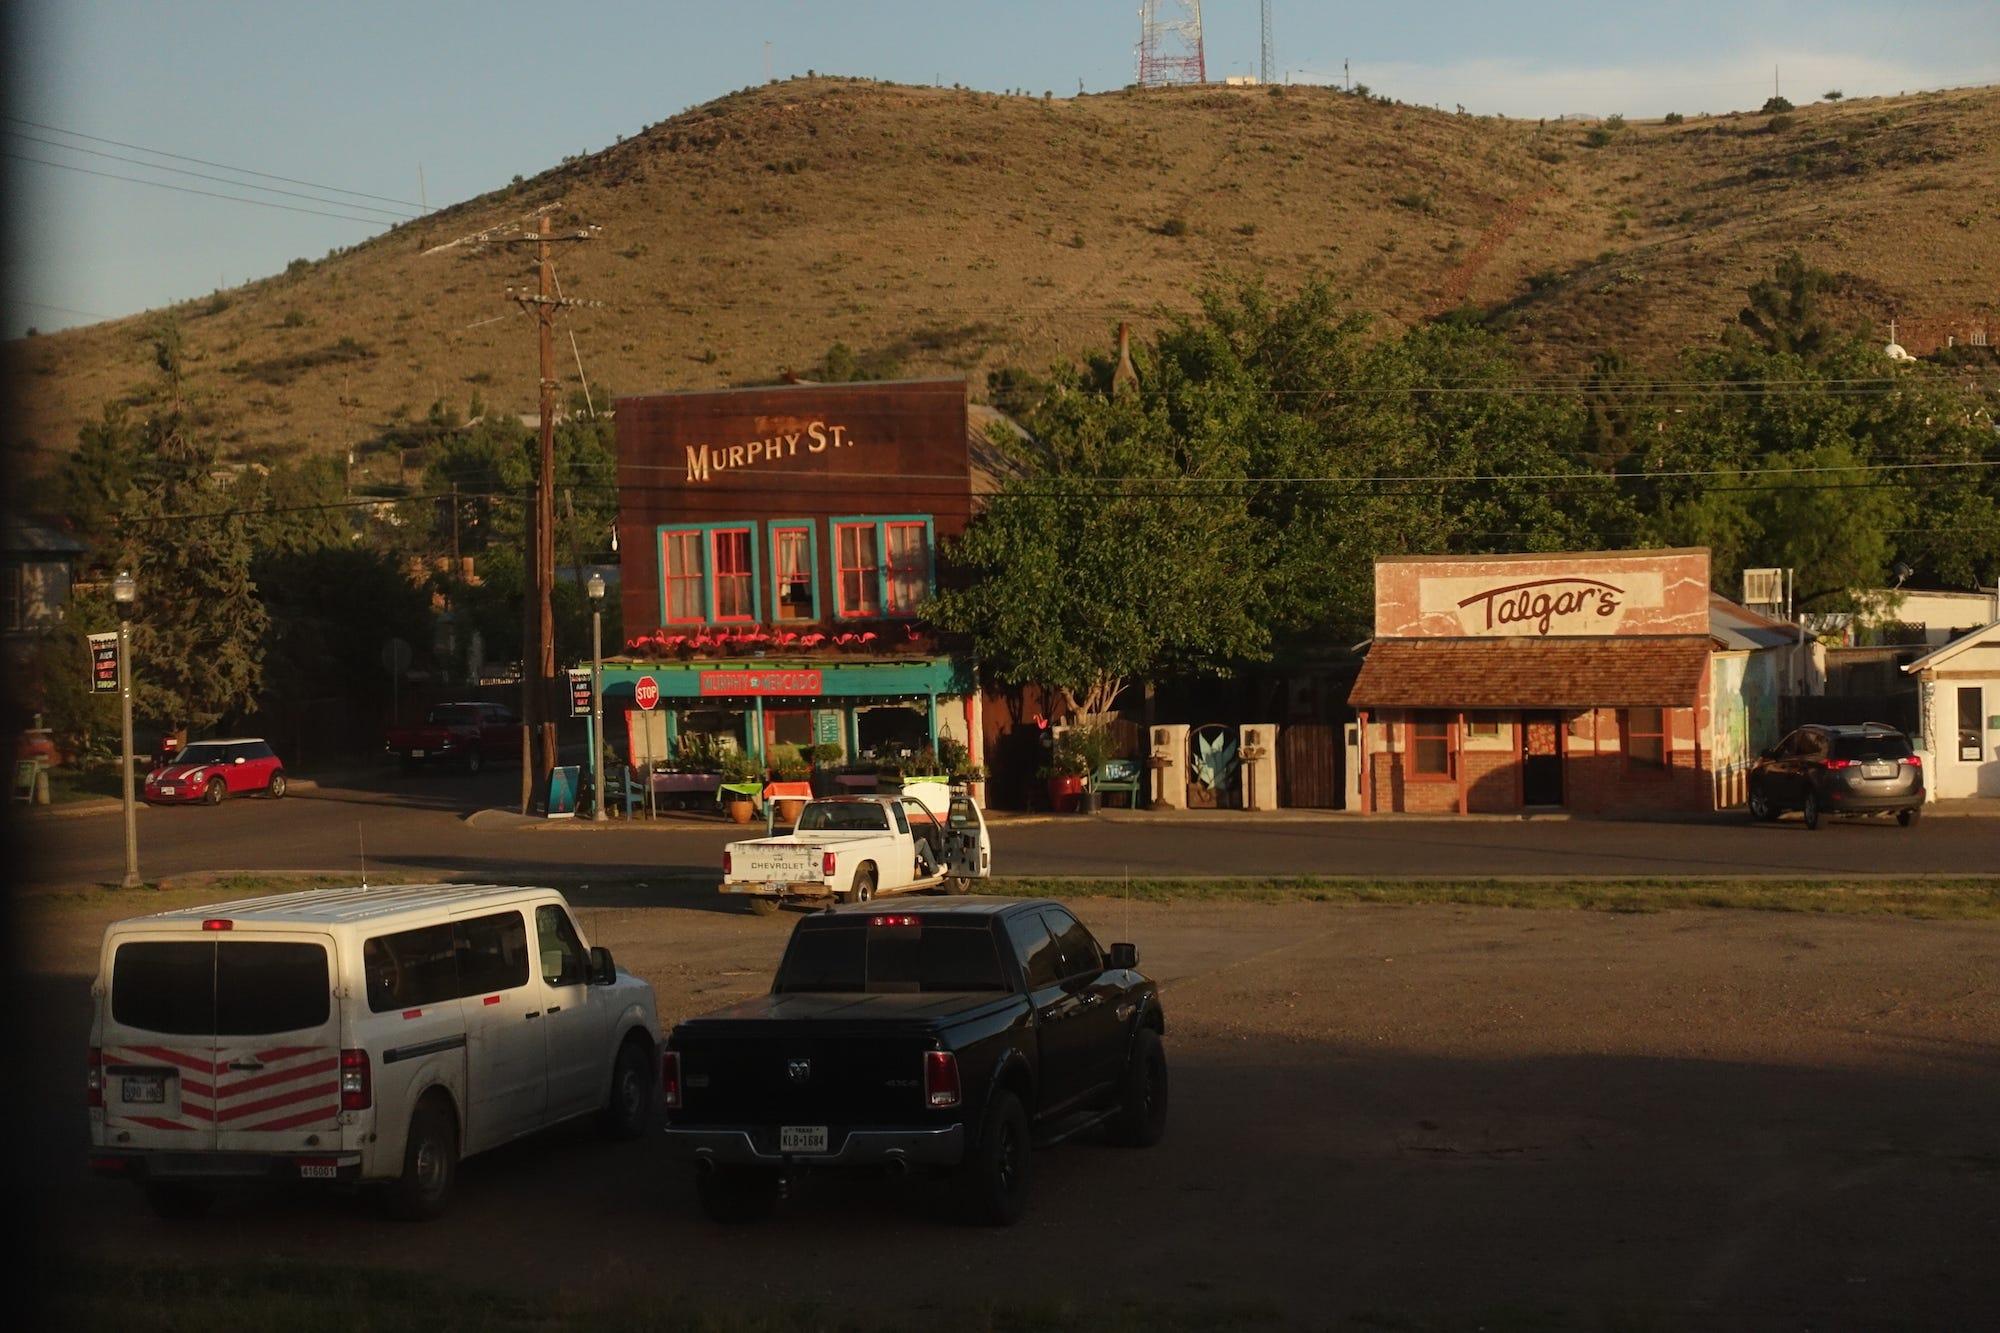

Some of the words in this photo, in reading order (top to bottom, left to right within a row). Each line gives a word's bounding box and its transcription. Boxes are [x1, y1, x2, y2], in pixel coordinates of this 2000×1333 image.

[1458, 577, 1625, 635] Talgar's
[762, 674, 818, 690] MERCADO
[637, 686, 657, 699] STOP
[751, 862, 804, 870] CHEVROLET
